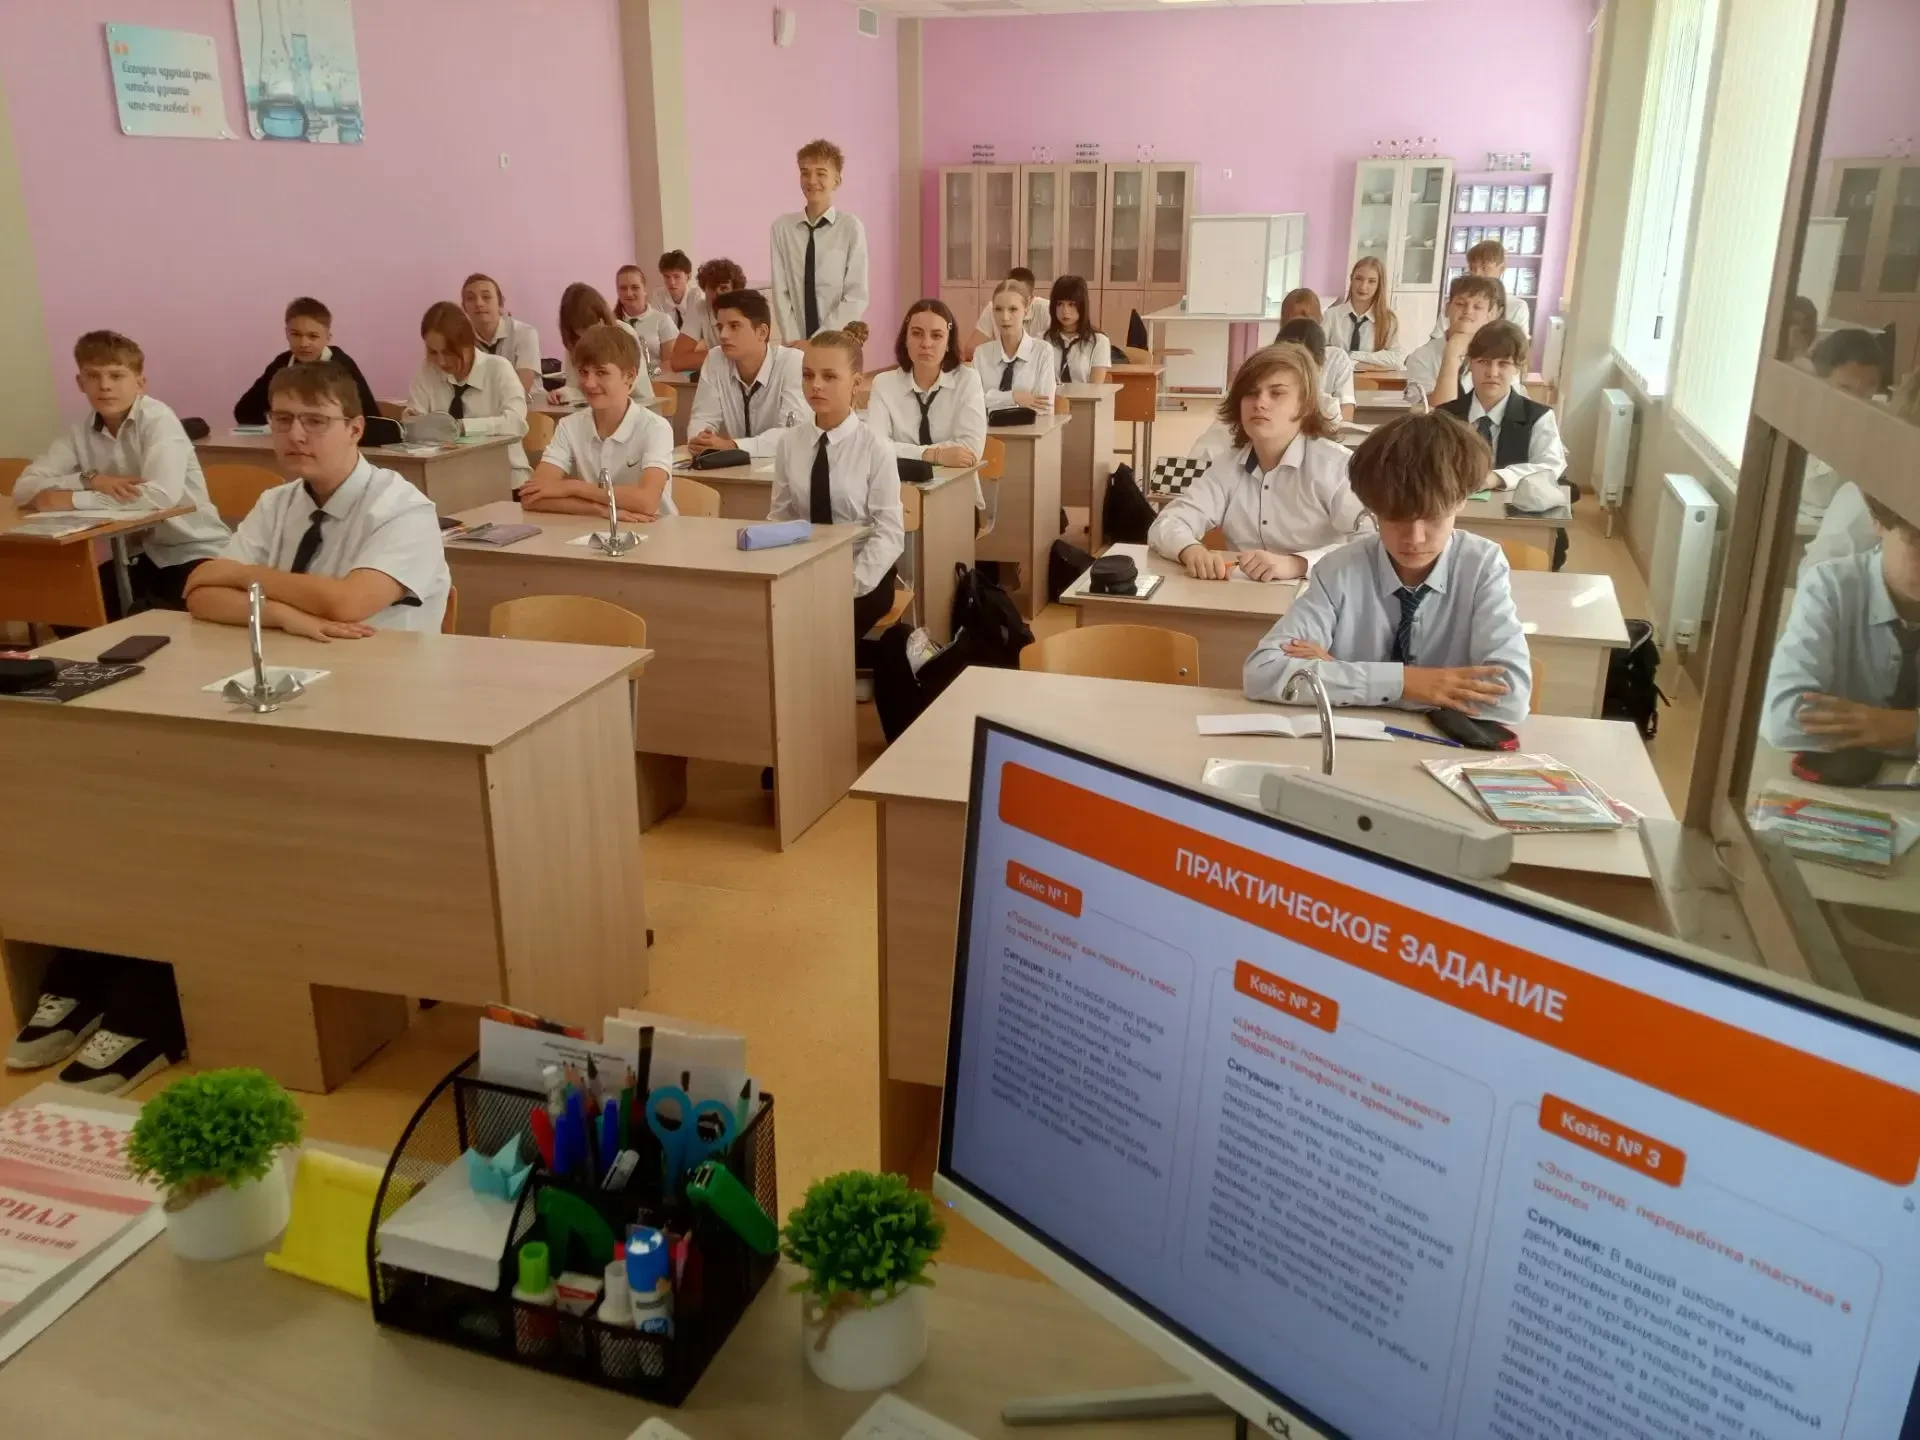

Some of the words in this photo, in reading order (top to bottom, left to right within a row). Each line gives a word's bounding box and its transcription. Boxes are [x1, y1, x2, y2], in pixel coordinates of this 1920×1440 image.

[1018, 871, 1044, 895] Кейс
[1047, 884, 1061, 902] №
[1063, 891, 1068, 905] 1
[1175, 847, 1390, 954] ПРАКТИЧЕСКОЕ
[1398, 932, 1567, 1023] ЗАДАНИЕ
[1249, 973, 1285, 1003] Кейс
[1288, 990, 1308, 1013] №
[1310, 999, 1321, 1018] 2
[1226, 1056, 1283, 1094] Ситуация:
[1560, 1110, 1611, 1148] Кейс
[1614, 1132, 1643, 1162] №
[1645, 1146, 1662, 1170] 3
[1520, 1244, 1618, 1303] пластиковых
[1623, 1294, 1691, 1341] бутылок
[1523, 1226, 1560, 1252] день
[1563, 1246, 1672, 1309] выбрасывают
[1675, 1303, 1746, 1347] десятки
[1527, 1205, 1605, 1255] Ситуация:
[1624, 1257, 1677, 1291] вашей
[1681, 1285, 1735, 1320] школе
[1740, 1314, 1814, 1359] каждый
[1636, 1204, 1745, 1264] переработка
[1748, 1257, 1835, 1307] пластика
[1513, 1281, 1550, 1311] сбор
[1566, 1309, 1637, 1358] отправку
[1640, 1349, 1719, 1399] пластика
[1722, 1393, 1745, 1414] на
[1517, 1260, 1539, 1282] Вы
[1543, 1276, 1592, 1310] хотите
[1596, 1304, 1707, 1371] организовать
[1710, 1365, 1822, 1432] раздельный
